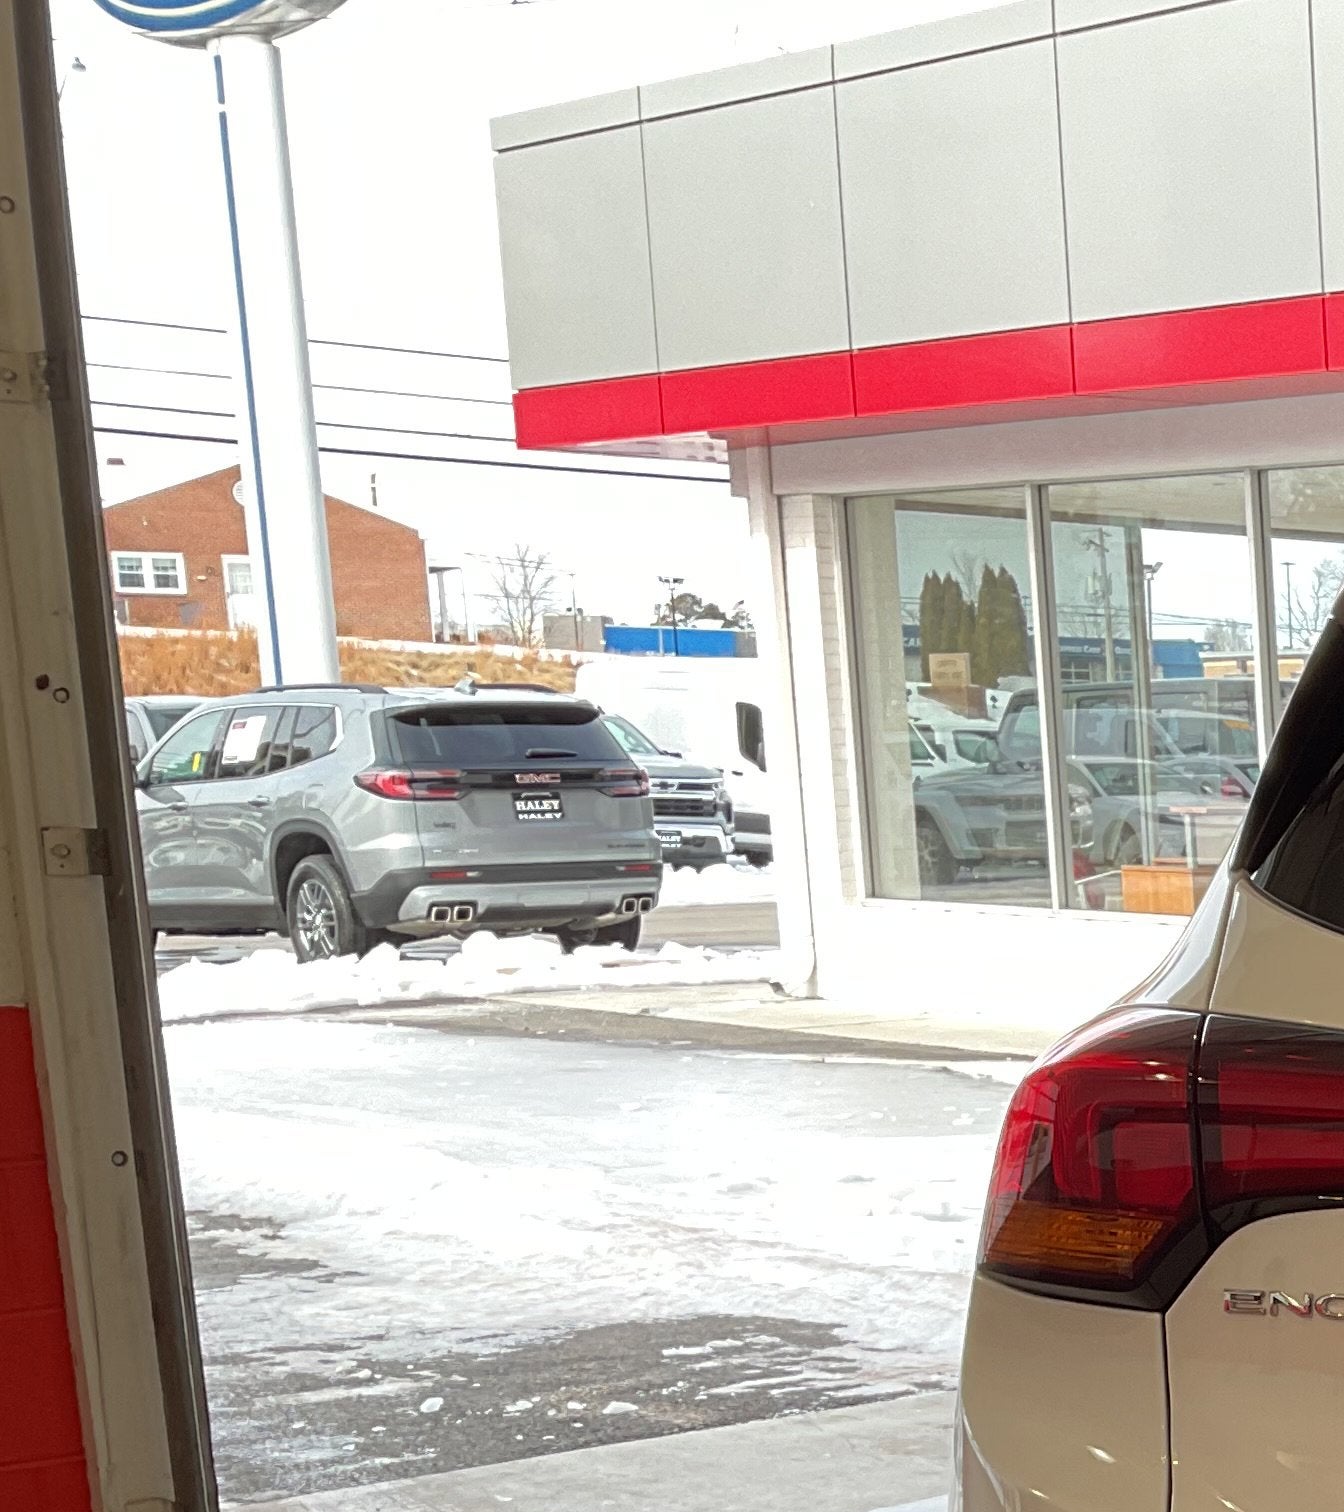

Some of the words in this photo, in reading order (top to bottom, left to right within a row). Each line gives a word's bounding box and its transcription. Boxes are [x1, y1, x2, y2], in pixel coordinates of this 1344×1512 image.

[514, 773, 561, 784] GMC
[515, 799, 560, 811] HALEY
[518, 812, 562, 820] HALEY
